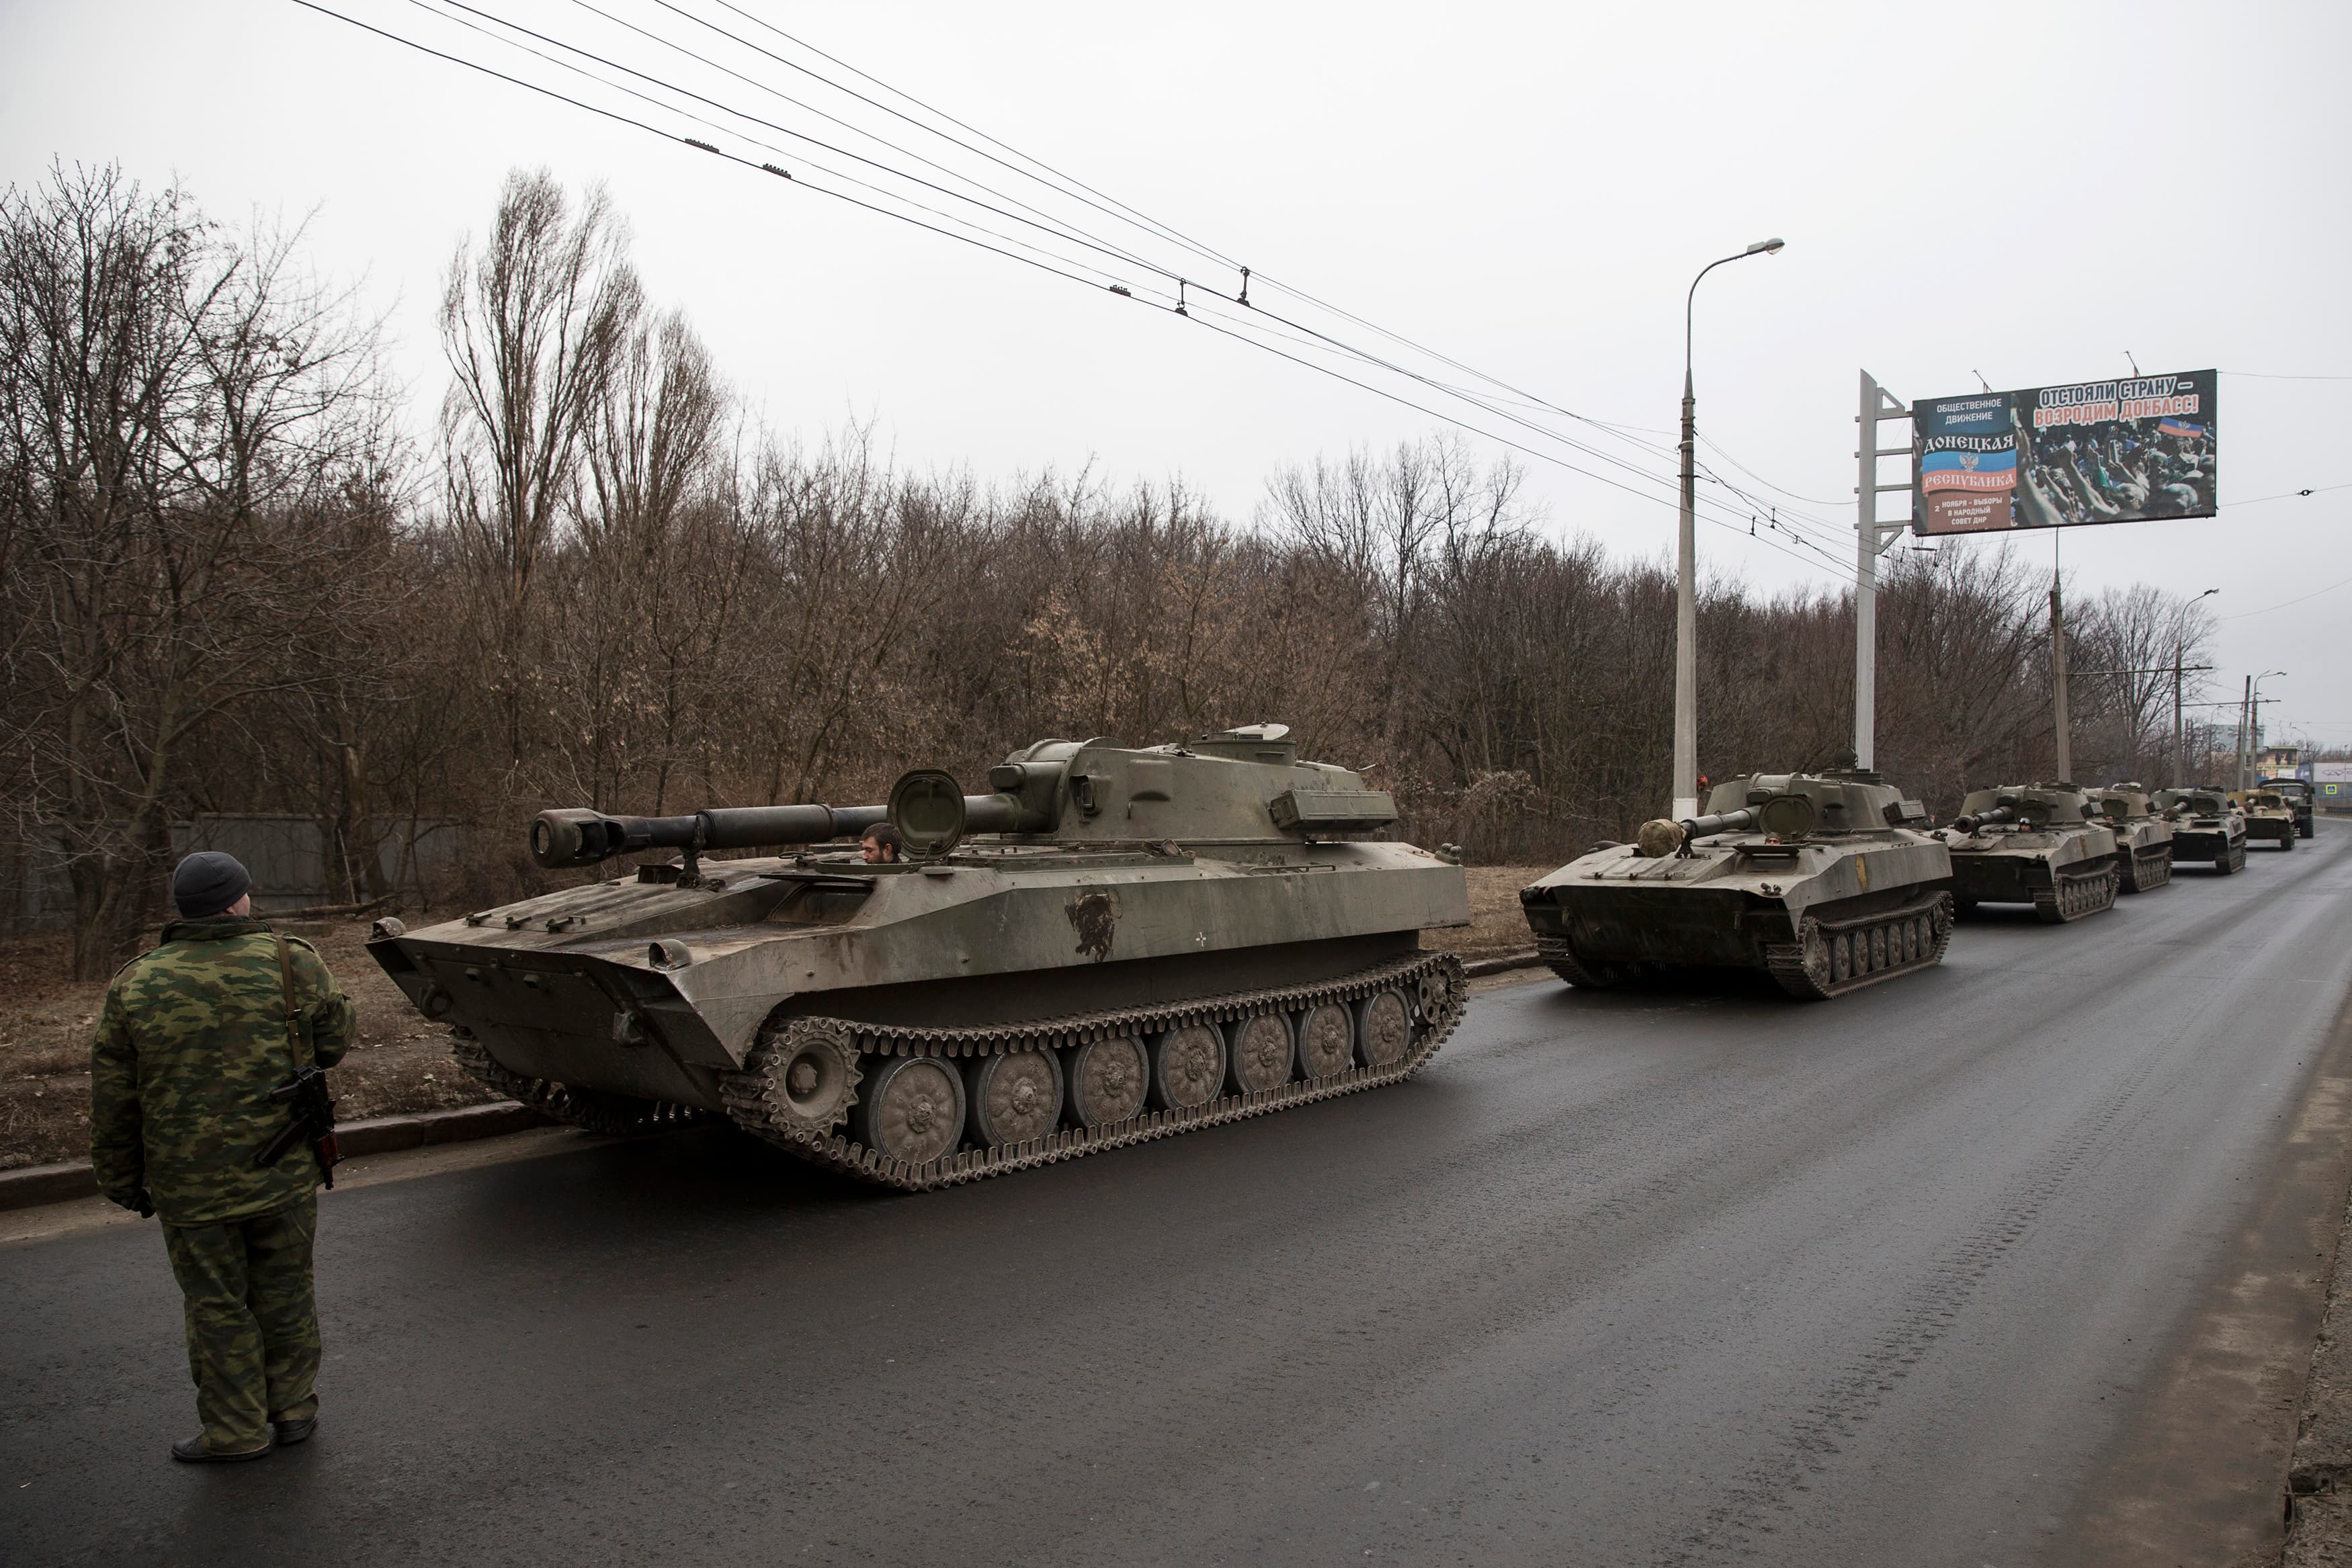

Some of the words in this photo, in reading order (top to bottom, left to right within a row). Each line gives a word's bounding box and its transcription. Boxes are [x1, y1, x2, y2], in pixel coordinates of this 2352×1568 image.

[2040, 383, 2115, 406] ОТСТОЯЛИ
[2120, 378, 2175, 398] СТРАНУ
[1937, 398, 2002, 413] ОБЩЕСТВЕННОЕ
[2035, 402, 2116, 426] ВОЗРОДИМ
[2120, 396, 2198, 421] ДОНБАСС!
[1945, 412, 1992, 425] ДВИЖЕНИЕ
[1924, 434, 2015, 454] ДОНЕЦКАЯ
[1925, 473, 2014, 488] РЕСПУБЛИКА
[1941, 500, 1967, 508] НОЯБРЯ
[1974, 497, 2003, 505] ВЫБОРЫ
[1954, 505, 1990, 516] НАРОДНЫЙ
[1973, 516, 1987, 525] ДНР
